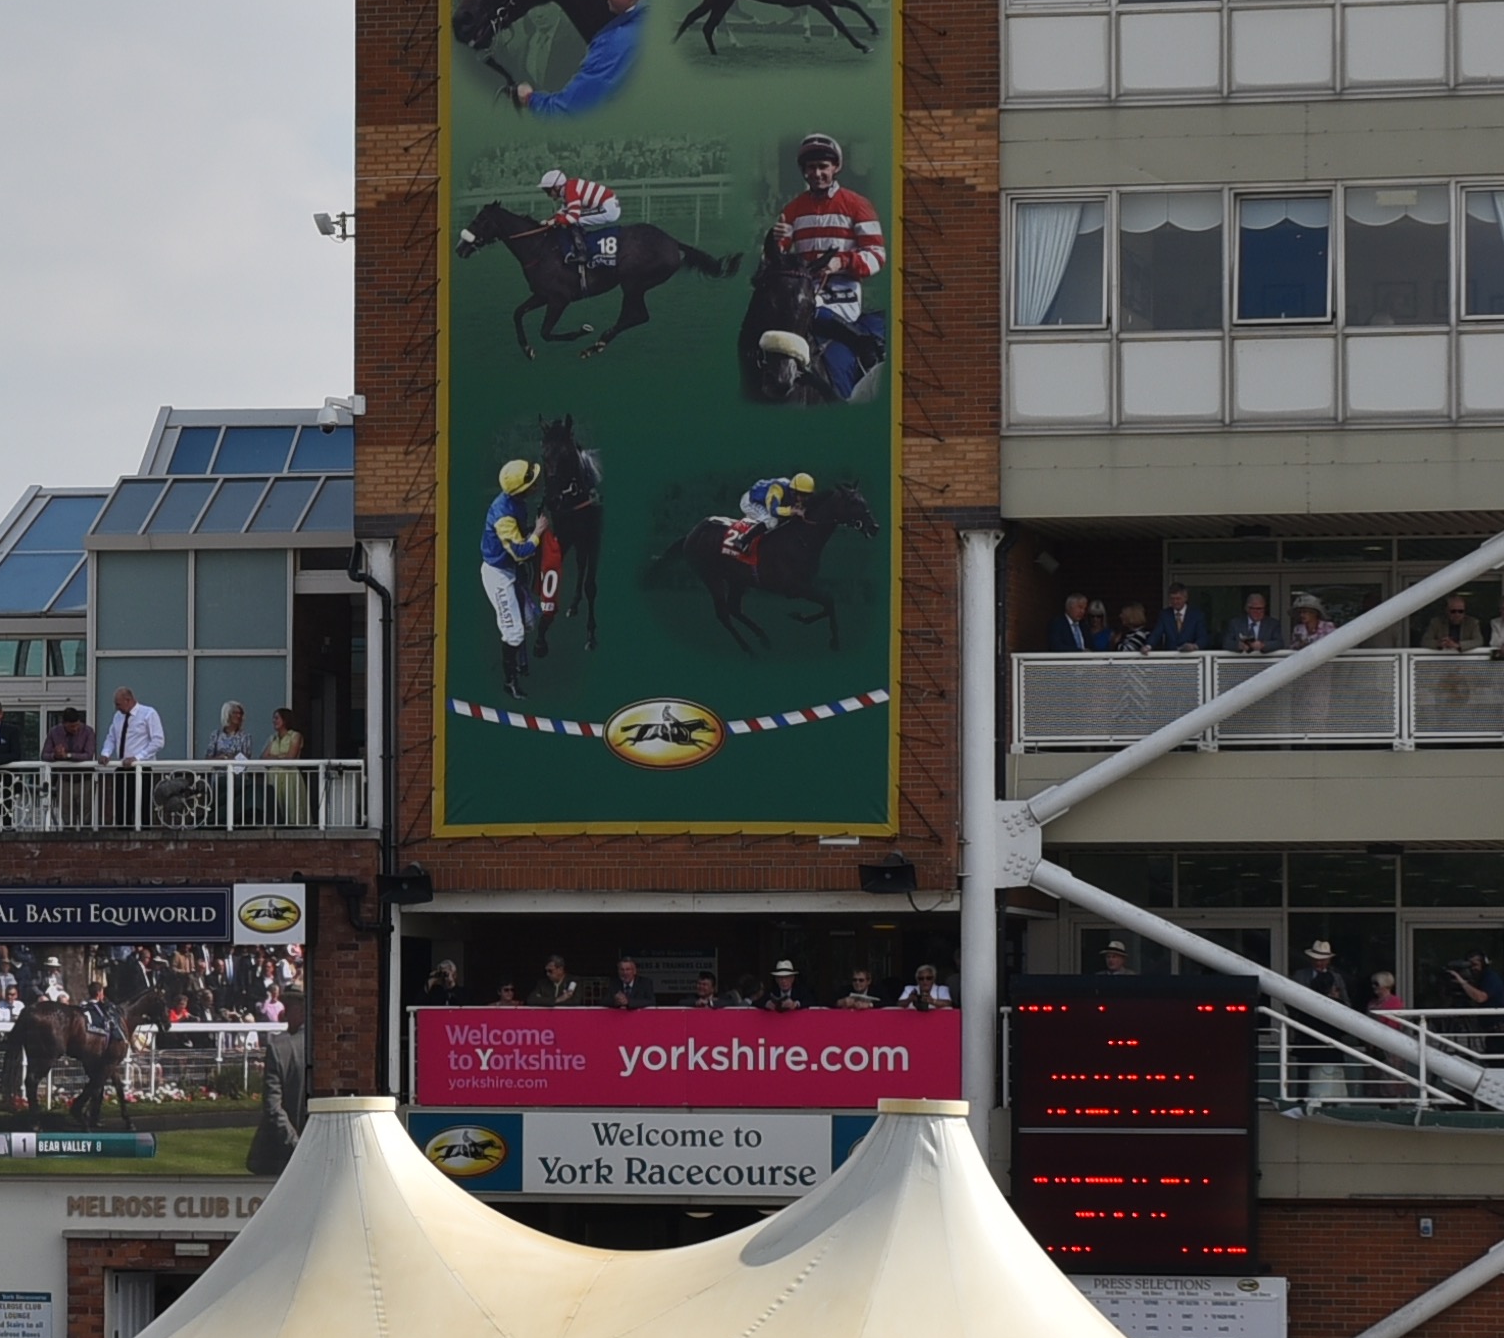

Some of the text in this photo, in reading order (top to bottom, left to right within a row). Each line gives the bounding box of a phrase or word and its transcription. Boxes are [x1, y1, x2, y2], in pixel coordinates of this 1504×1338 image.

[596, 236, 618, 255] 18
[26, 903, 82, 924] BASTI
[90, 903, 217, 925] EQUIWORLD
[445, 1023, 555, 1046] Welcome
[475, 1047, 586, 1071] Yorkshire
[618, 1036, 910, 1078] yorkshire.com
[448, 1075, 548, 1091] yorkshire.com
[591, 1122, 762, 1148] Welcome to
[20, 1137, 28, 1154] 1
[37, 1140, 59, 1153] BEAR
[60, 1140, 92, 1153] VALLEY
[538, 1156, 817, 1187] York Racecourse
[66, 1195, 167, 1218] MELROSE
[173, 1196, 230, 1219] CLUB
[1093, 1277, 1212, 1291] PRESS SELECTIONS
[4, 1312, 31, 1320] LOUNGE
[24, 1303, 42, 1311] CLUB
[6, 1321, 25, 1329] Stairs
[26, 1321, 34, 1329] to
[35, 1321, 44, 1329] all
